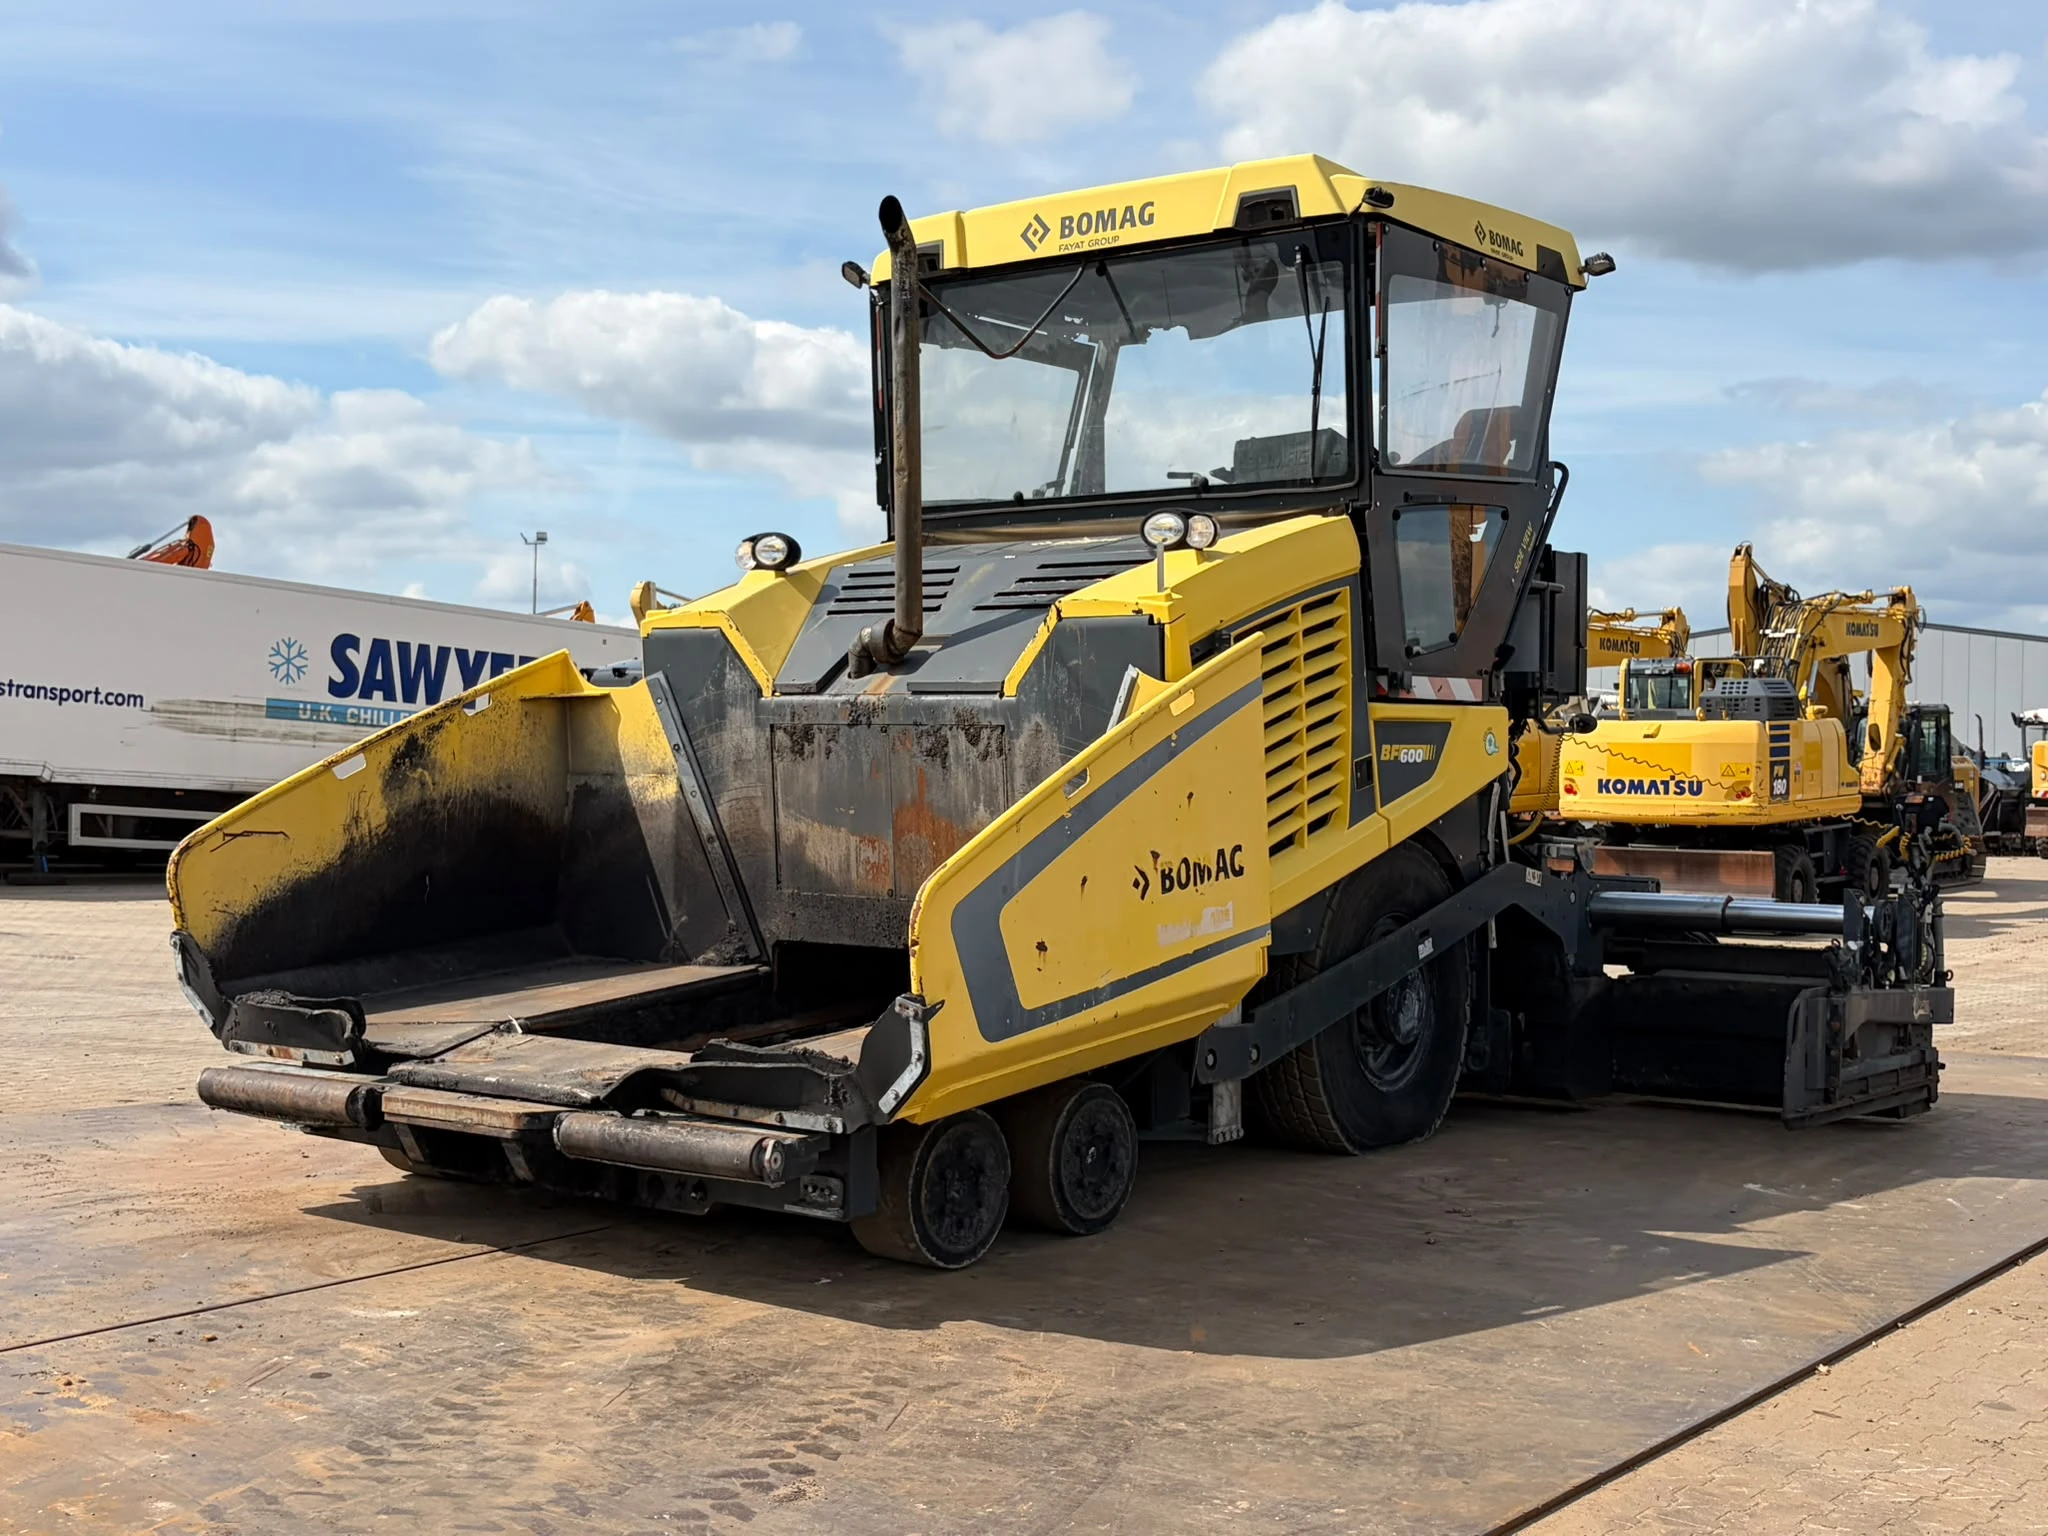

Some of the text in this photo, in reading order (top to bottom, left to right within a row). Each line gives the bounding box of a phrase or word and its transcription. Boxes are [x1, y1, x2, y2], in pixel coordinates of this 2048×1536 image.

[1059, 201, 1155, 240] BOMAG
[1058, 235, 1120, 253] FAYAT GROUP
[1488, 229, 1524, 257] BOMAG
[1599, 636, 1641, 654] KOMATSU
[327, 633, 540, 711] SAWY
[0, 678, 144, 708] stransport.com
[298, 703, 337, 722] U.K.
[1597, 775, 1704, 797] KOMATSU
[1160, 844, 1245, 895] BOMAG
